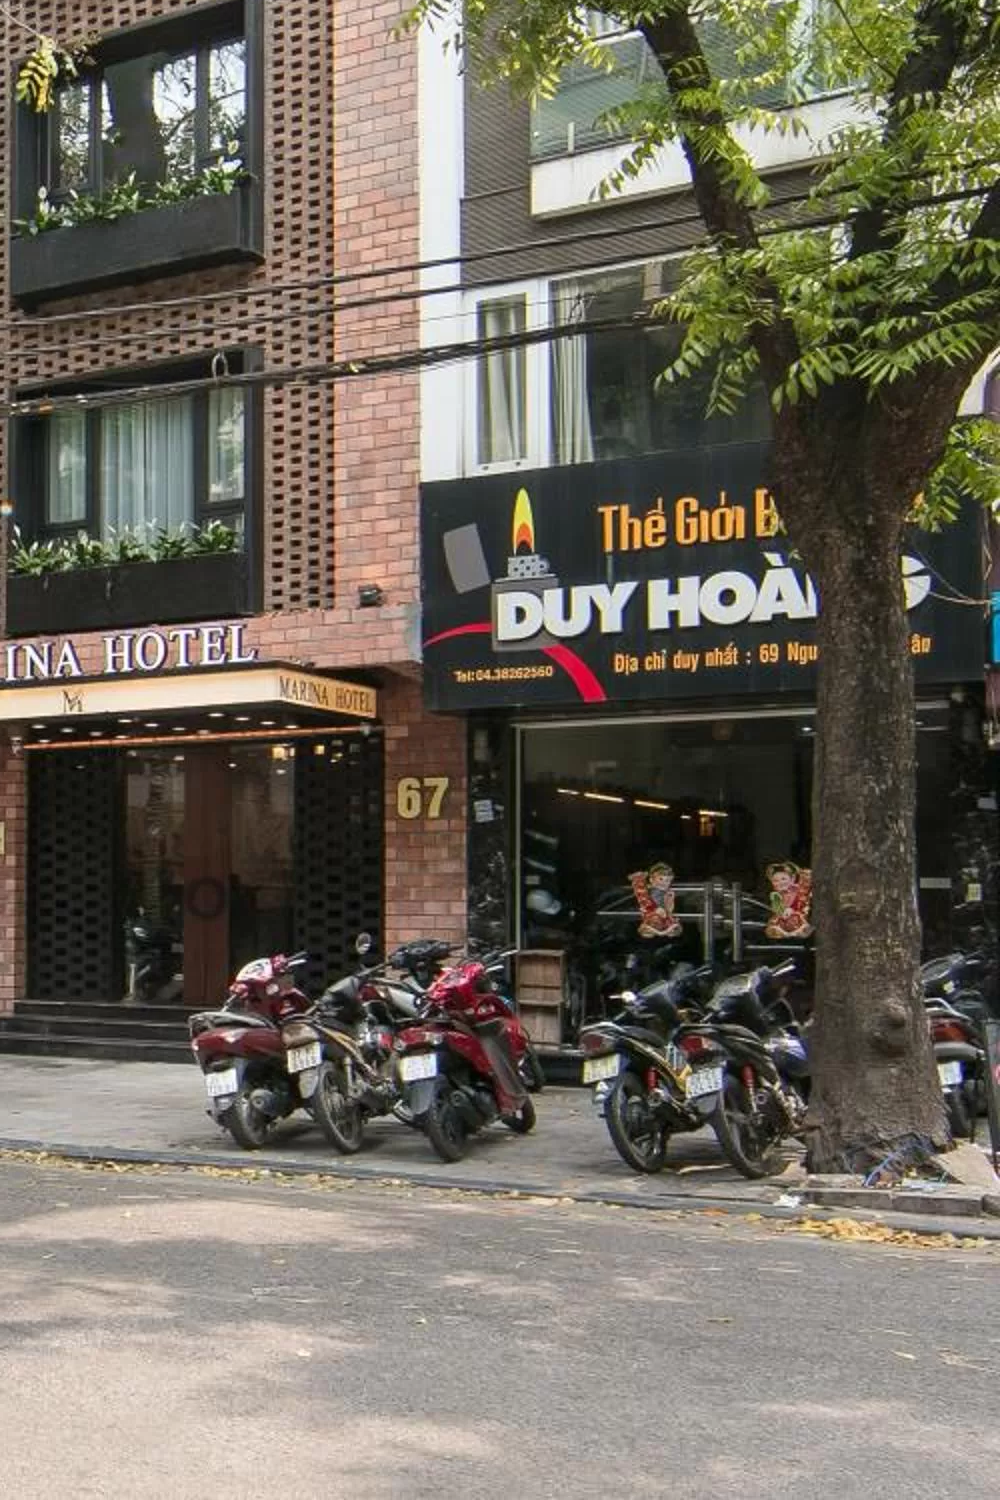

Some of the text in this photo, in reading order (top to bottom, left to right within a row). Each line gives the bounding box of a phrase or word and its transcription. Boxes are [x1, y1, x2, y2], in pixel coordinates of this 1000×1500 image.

[597, 497, 667, 552] Thế
[497, 552, 931, 641] DUY HOÀG
[104, 624, 257, 674] HOTEL
[673, 649, 699, 673] duy
[759, 643, 779, 663] 69
[787, 641, 819, 666] Ngu
[279, 676, 372, 713] MARINA HOTEL
[397, 777, 449, 819] 67
